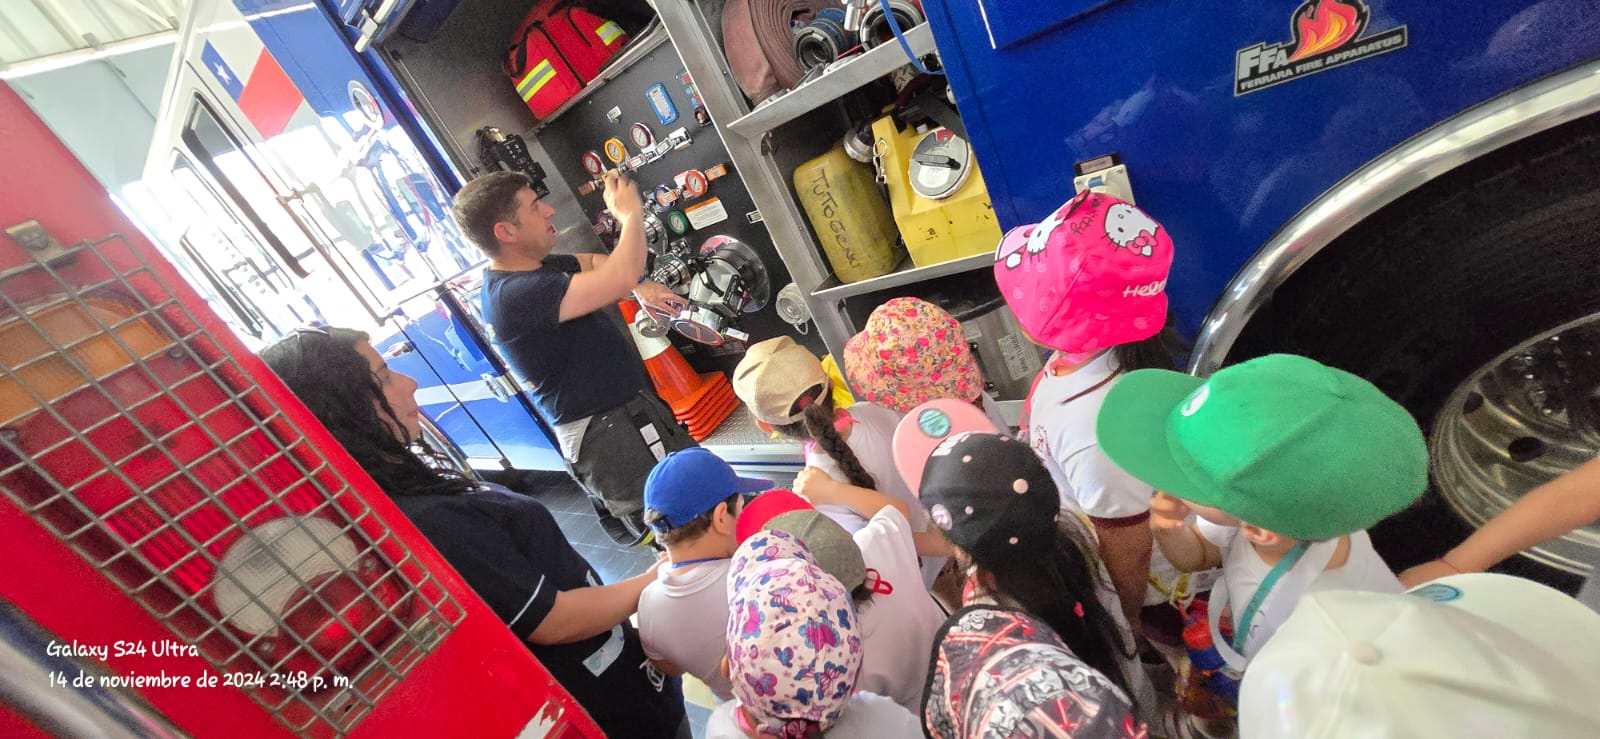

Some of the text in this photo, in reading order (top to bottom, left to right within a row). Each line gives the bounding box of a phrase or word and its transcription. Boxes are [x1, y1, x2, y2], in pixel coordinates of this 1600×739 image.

[1238, 46, 1289, 80] FFA
[1240, 34, 1403, 91] FERRARA FIRE APPARATUS
